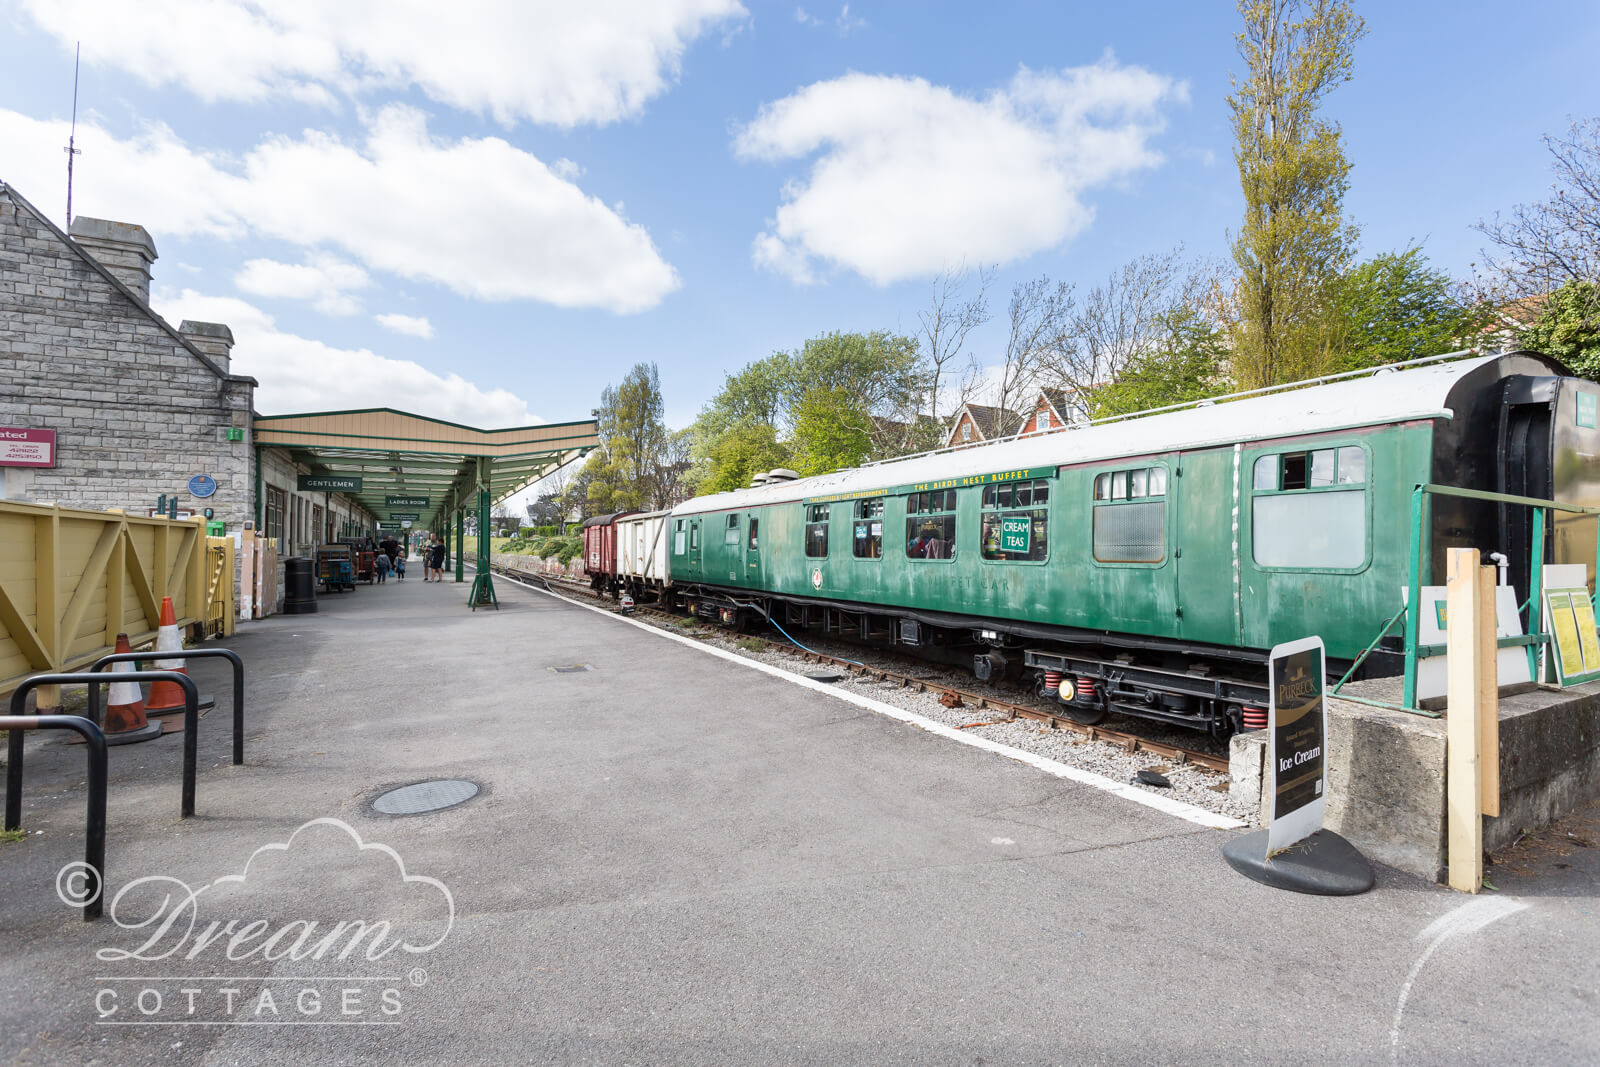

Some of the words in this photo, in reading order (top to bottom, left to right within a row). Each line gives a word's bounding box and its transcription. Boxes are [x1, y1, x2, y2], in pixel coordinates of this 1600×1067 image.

[307, 480, 354, 488] GENTLEMEN
[933, 480, 957, 489] BIRDS
[963, 475, 985, 485] NEST
[991, 469, 1029, 481] BUFFET
[1003, 521, 1029, 533] CREAM
[1006, 536, 1025, 547] TEAS
[1279, 679, 1317, 704] PURBECK
[1279, 757, 1293, 773] Ice
[1294, 746, 1321, 766] Cream
